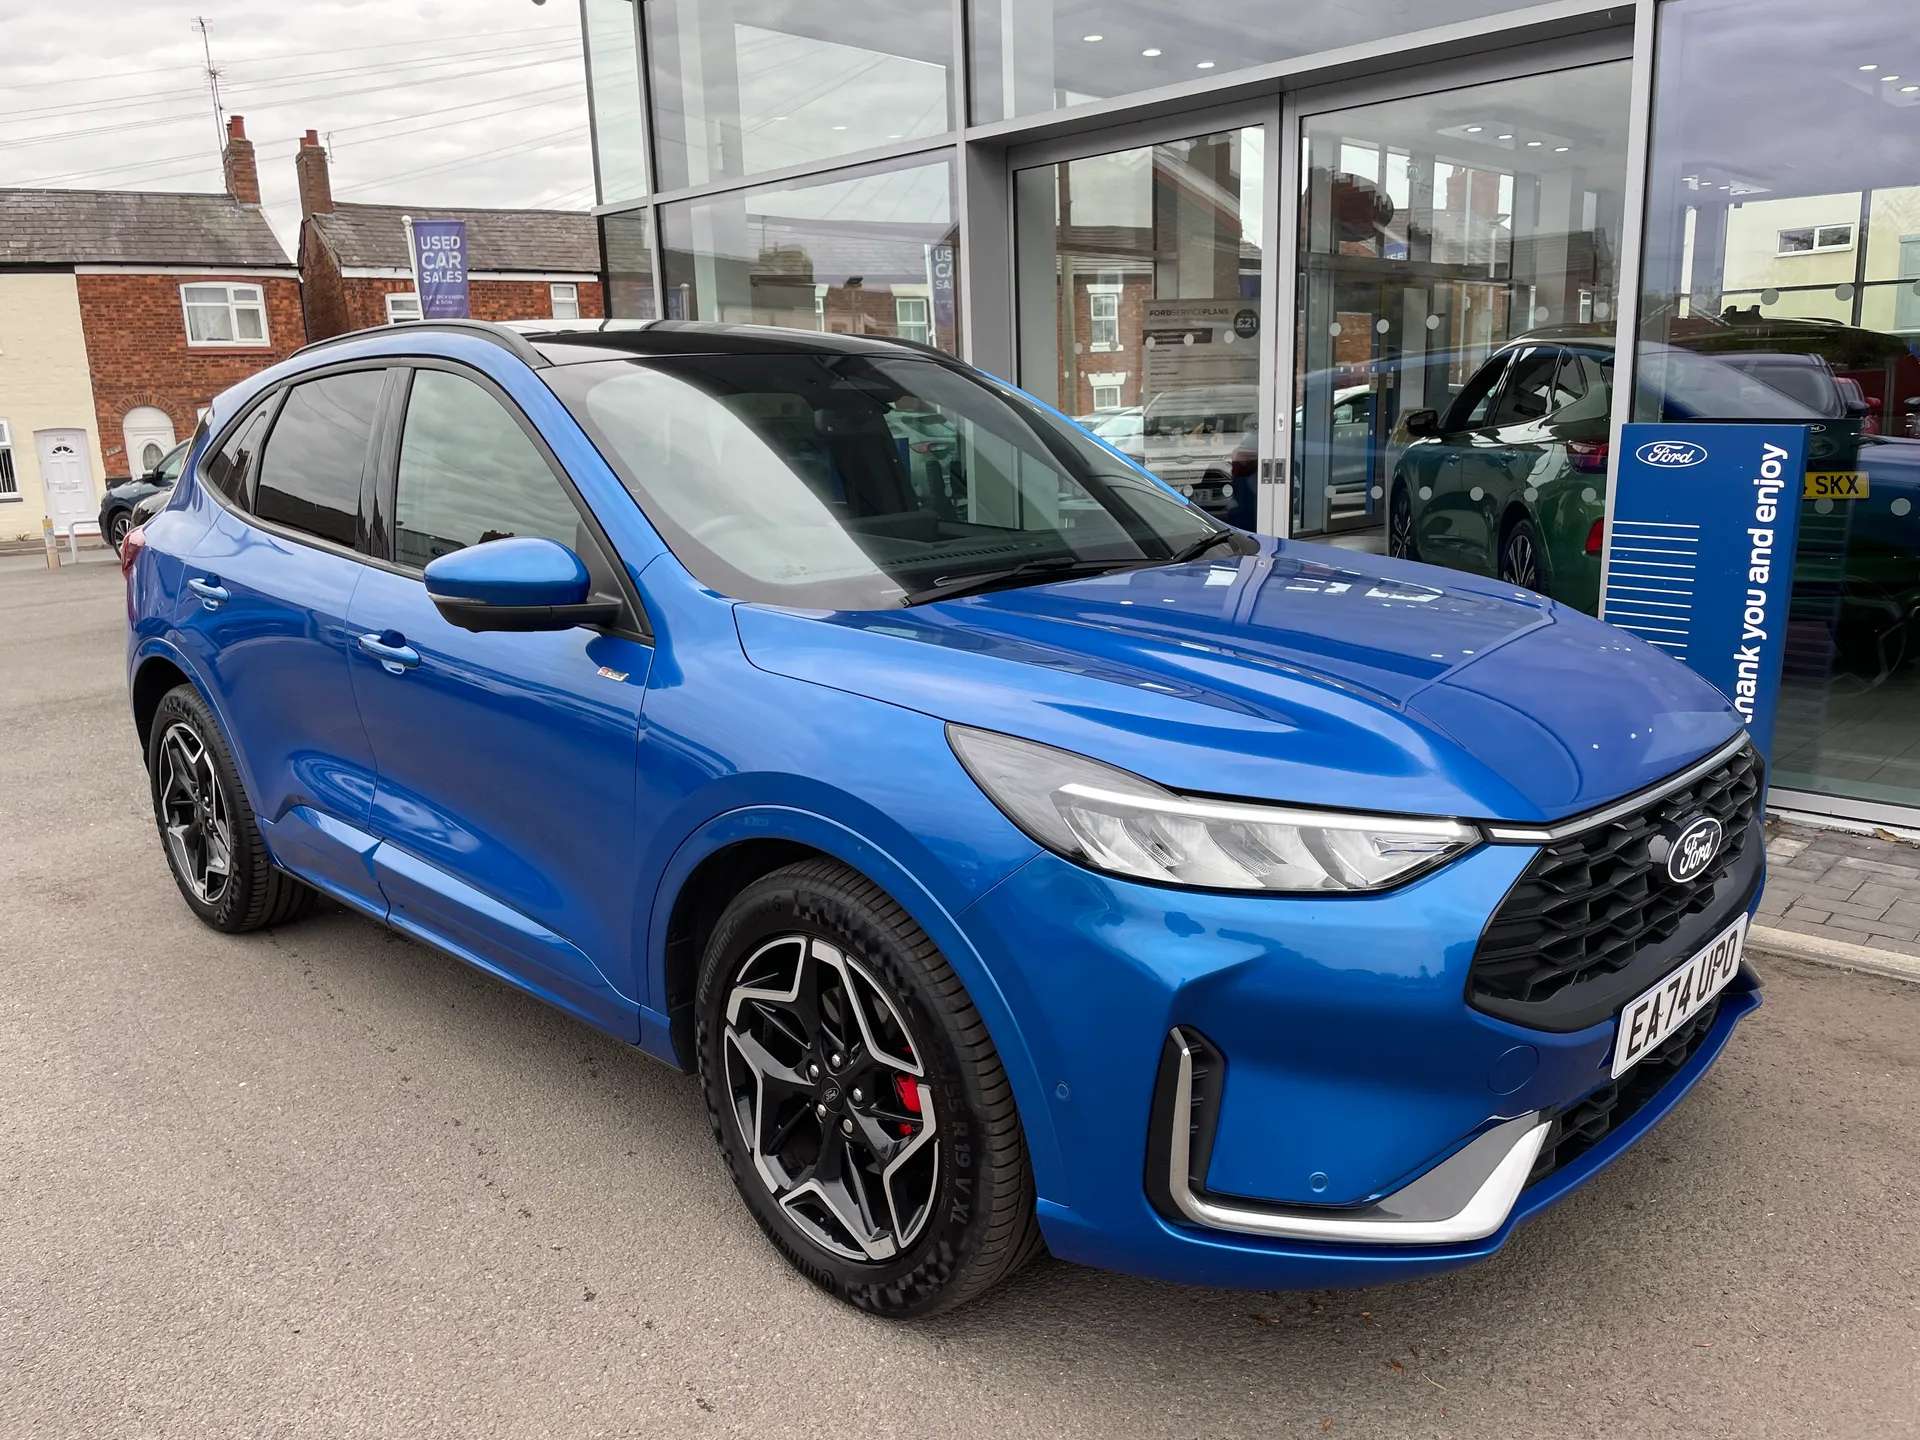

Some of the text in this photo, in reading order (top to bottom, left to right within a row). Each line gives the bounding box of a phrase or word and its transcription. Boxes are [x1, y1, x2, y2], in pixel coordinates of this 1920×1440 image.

[420, 235, 461, 250] USED
[421, 251, 462, 269] CAR
[422, 270, 463, 284] SALES
[1815, 474, 1859, 495] SKX
[1733, 443, 1789, 724] hank you and enjoy
[1679, 828, 1713, 875] Ford
[1626, 929, 1738, 1061] EA74 UPO
